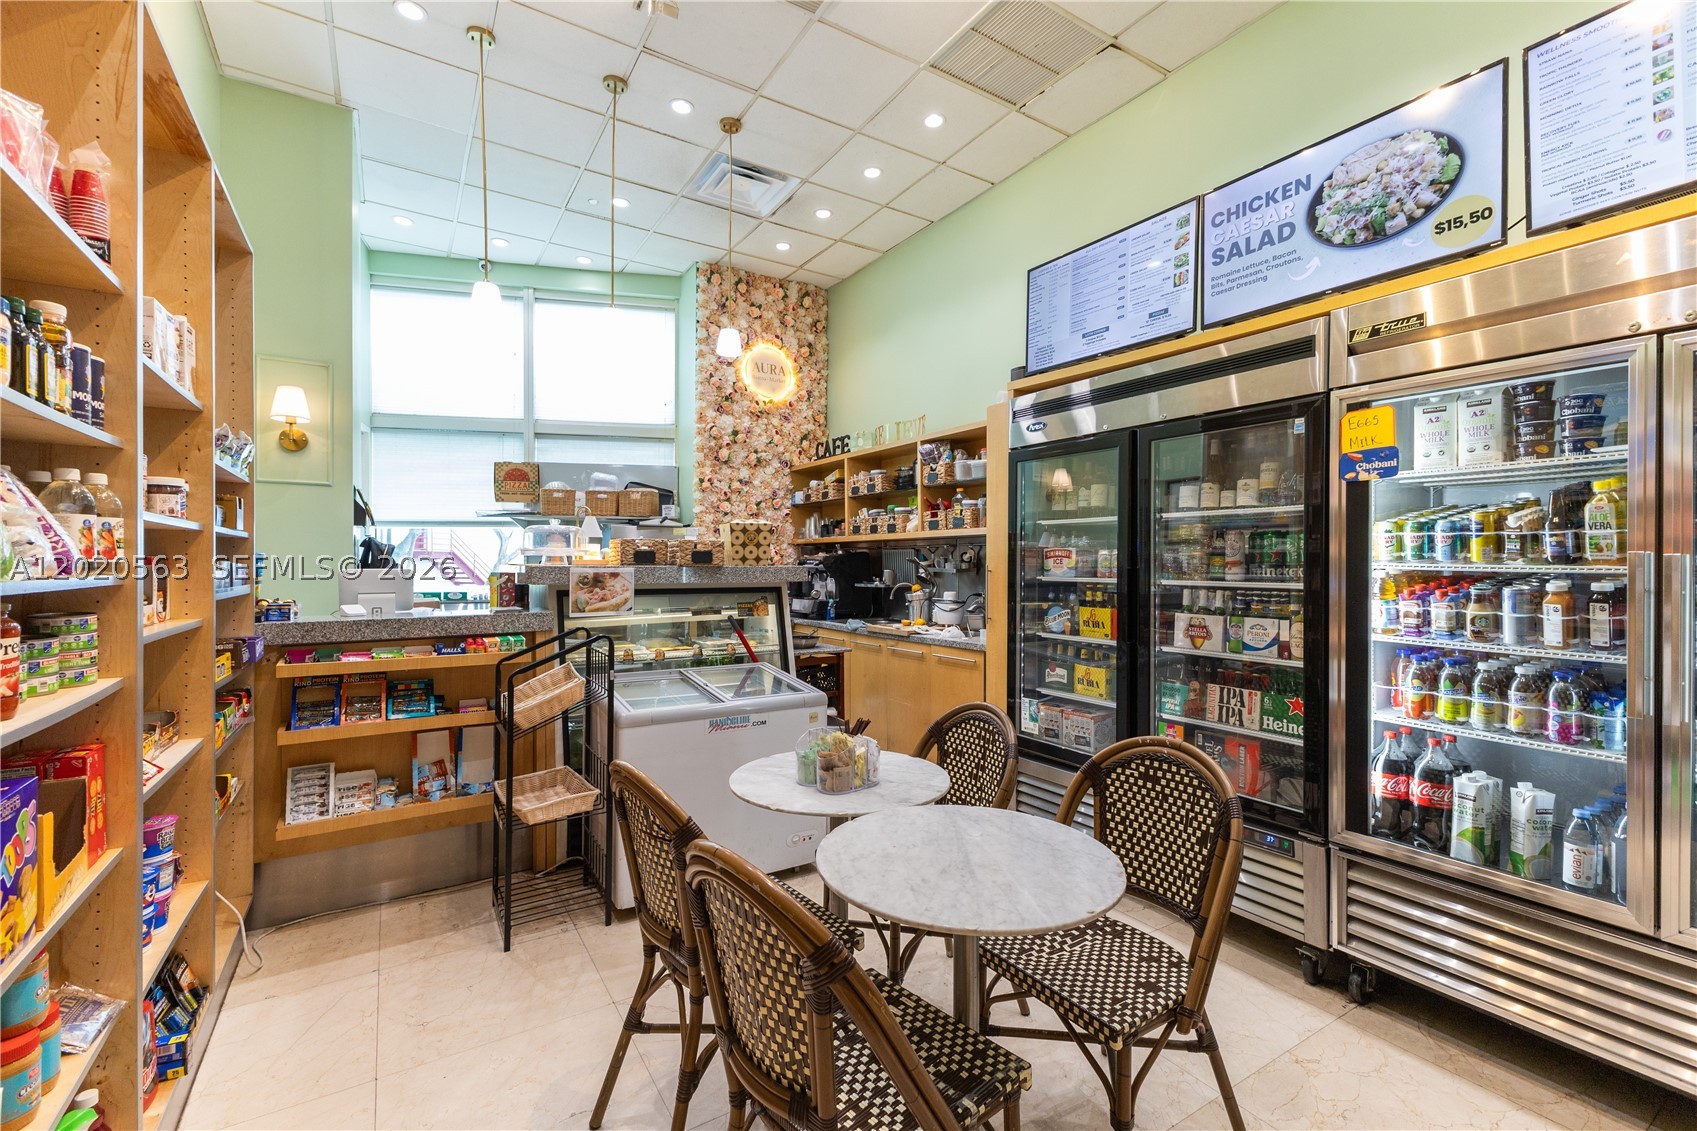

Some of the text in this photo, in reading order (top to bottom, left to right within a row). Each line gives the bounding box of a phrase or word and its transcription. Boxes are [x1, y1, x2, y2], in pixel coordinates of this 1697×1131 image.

[1583, 19, 1618, 39] SMOOT
[1211, 174, 1312, 229] CHICKEN
[1211, 201, 1296, 246] CAESAR
[1434, 206, 1493, 236] $15,50
[1212, 221, 1296, 267] SALAD
[1210, 247, 1296, 282] Romaine Lettuce, Bacon
[1210, 253, 1303, 290] Bits, Parmesan, Croutons,
[1210, 273, 1267, 297] Caesar Dressing
[753, 361, 786, 376] AURA
[1471, 410, 1485, 418] A2
[1561, 406, 1595, 416] Chobani
[1427, 416, 1440, 424] A2
[1420, 430, 1450, 439] WHOLE
[1464, 424, 1495, 433] WHOLE
[1469, 431, 1490, 439] MILK
[816, 434, 851, 459] CAFE
[1425, 436, 1445, 444] MILK
[1356, 458, 1397, 471] Chobani
[504, 481, 529, 491] PIZZA
[1589, 512, 1610, 522] ALOE
[1588, 522, 1612, 530] VERA
[1082, 619, 1106, 629] RUBIA
[1247, 627, 1270, 638] PERONI
[1078, 677, 1100, 689] RUBIA
[1208, 685, 1217, 720] LAGUNITAS
[1218, 686, 1246, 708] IPA
[1218, 704, 1244, 728] IPA
[1571, 854, 1582, 880] evian
